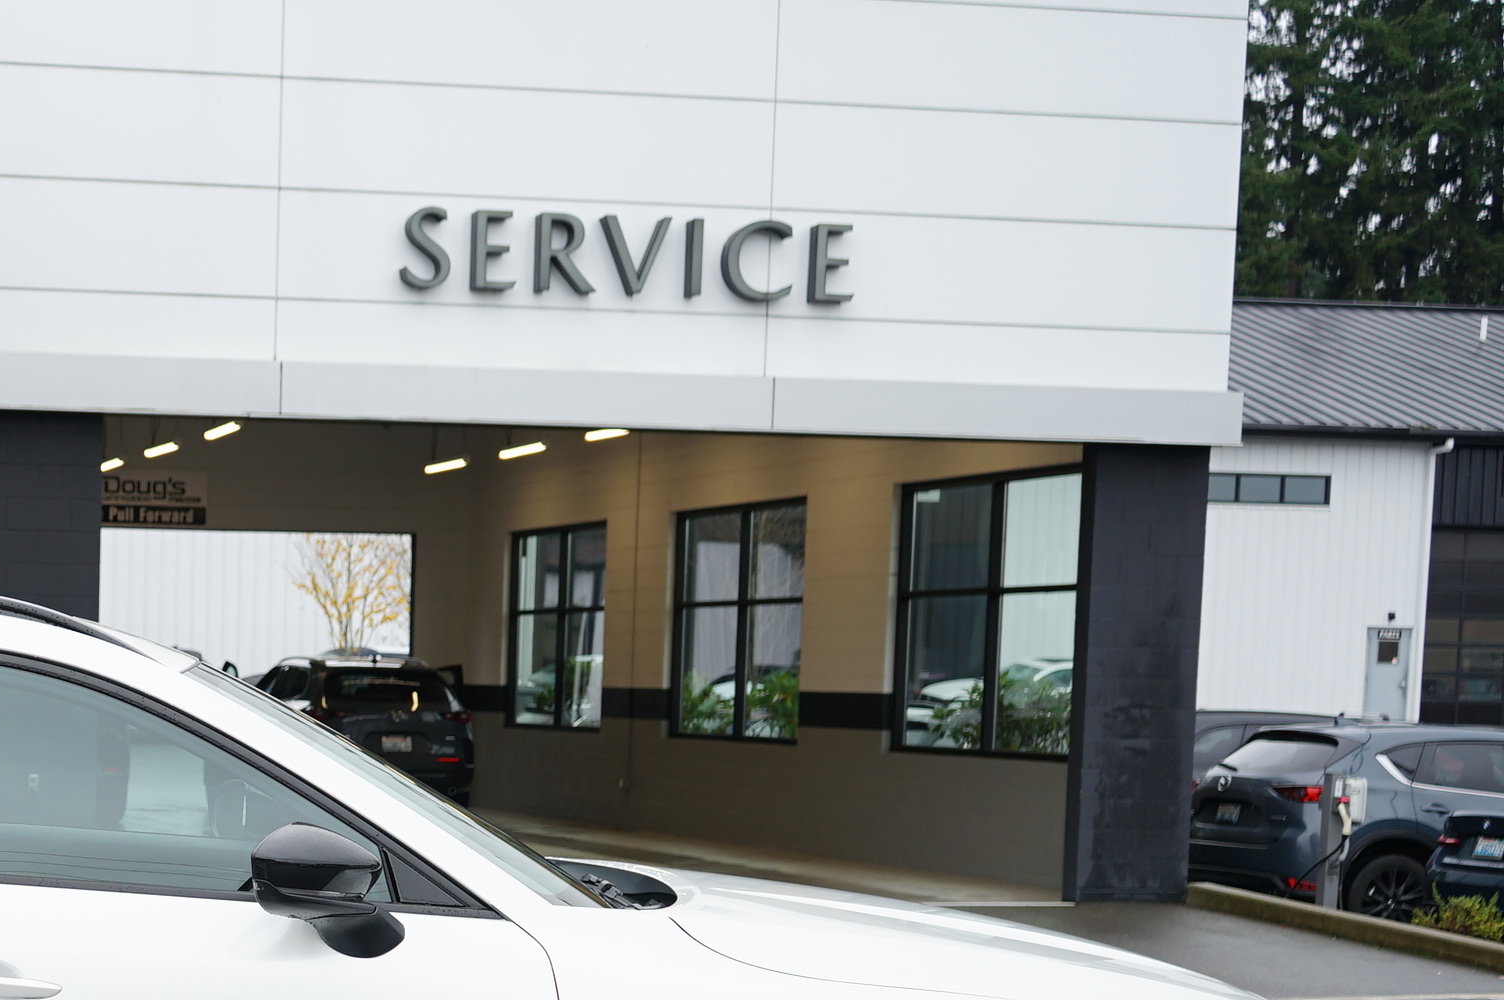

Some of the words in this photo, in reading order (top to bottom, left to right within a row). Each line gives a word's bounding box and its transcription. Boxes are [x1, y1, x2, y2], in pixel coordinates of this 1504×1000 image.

[398, 206, 855, 305] SERVICE
[101, 475, 186, 499] Doug's
[108, 506, 134, 522] Pull
[139, 507, 195, 524] Forward
